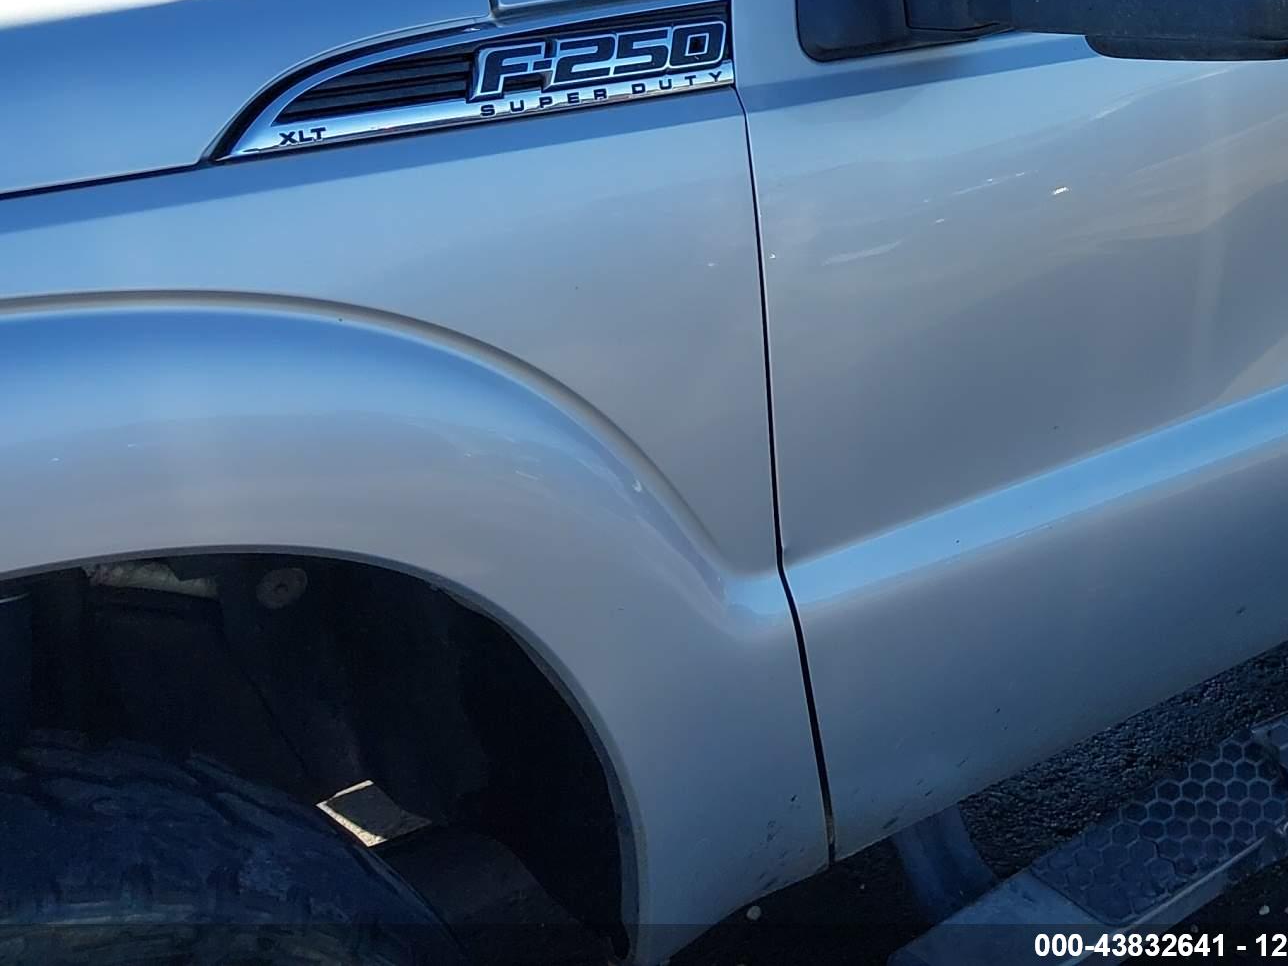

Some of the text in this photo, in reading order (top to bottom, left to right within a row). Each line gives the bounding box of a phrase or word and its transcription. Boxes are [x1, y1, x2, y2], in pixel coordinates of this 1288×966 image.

[474, 21, 727, 98] F-250
[480, 70, 724, 118] SUPER DUTY
[278, 127, 327, 146] XLT
